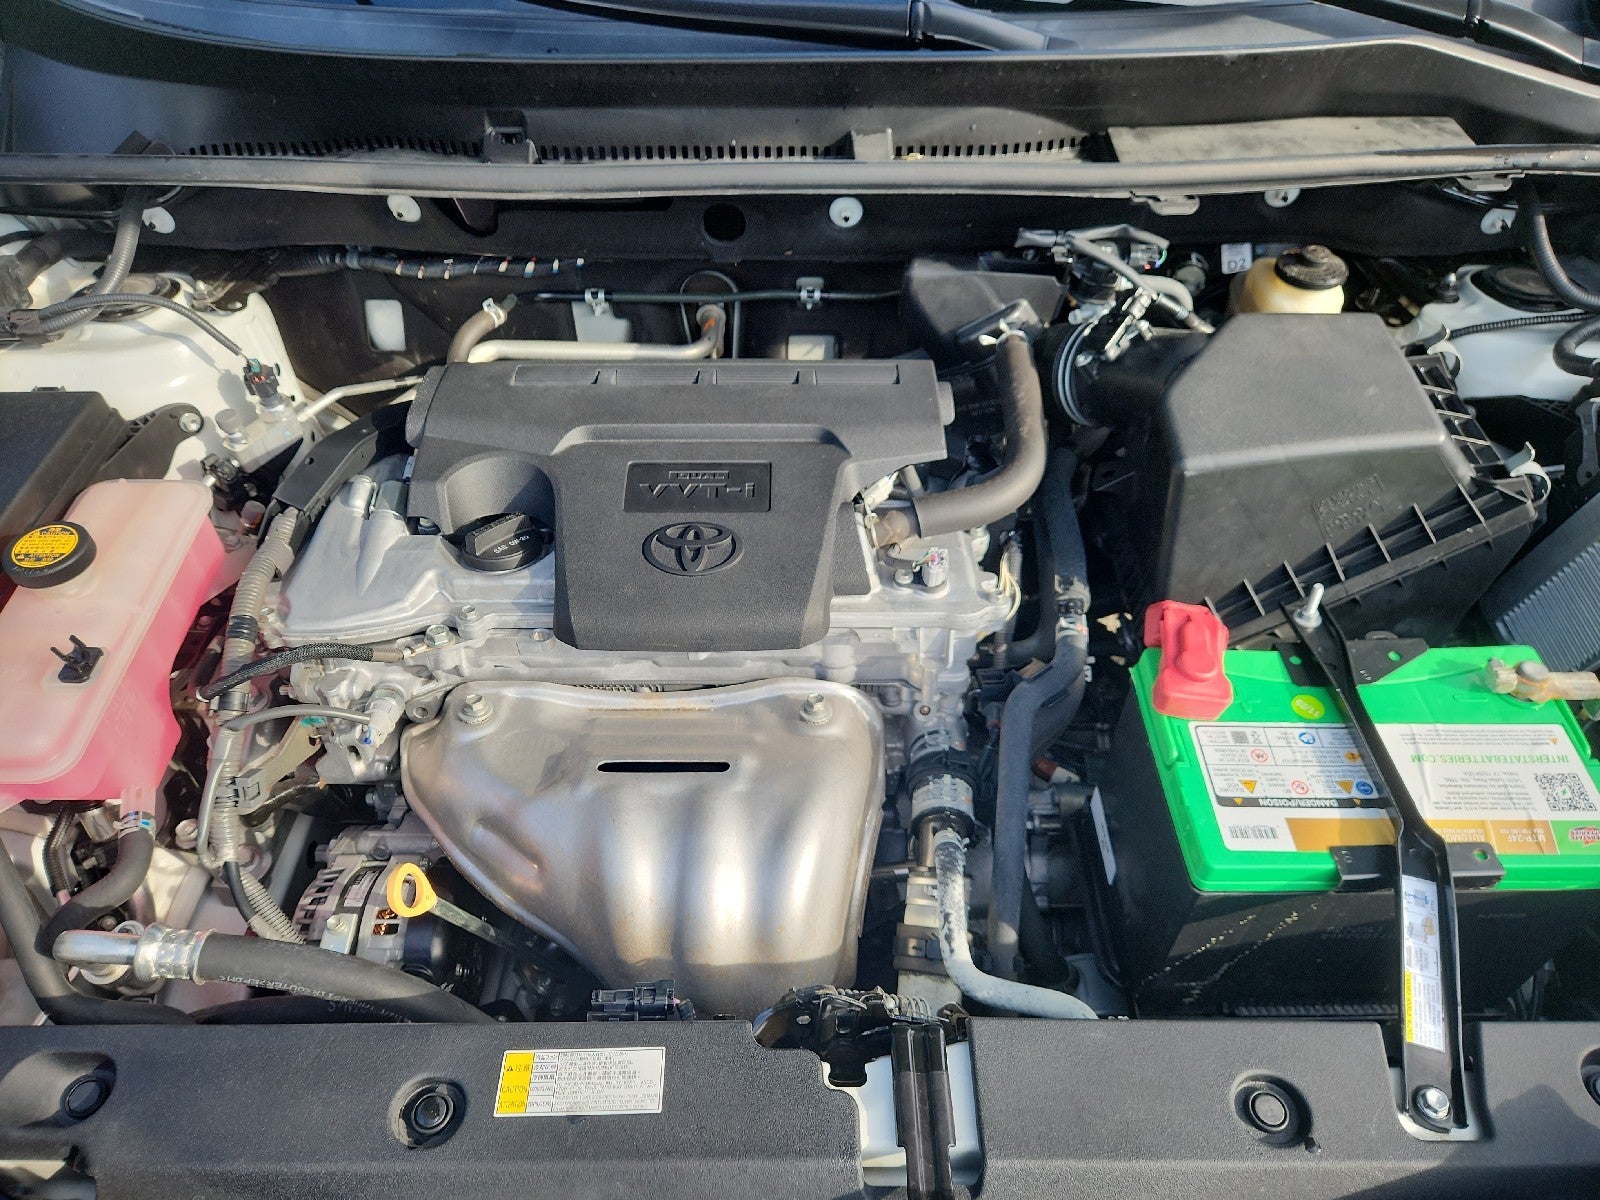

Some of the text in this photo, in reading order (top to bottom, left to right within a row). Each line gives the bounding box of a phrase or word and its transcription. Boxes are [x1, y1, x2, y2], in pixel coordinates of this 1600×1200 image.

[1227, 258, 1246, 272] D2
[639, 482, 756, 498] VVT-i
[493, 535, 530, 554] SAE 0W-20
[1410, 754, 1569, 763] INTERSTATEBATTERIES.COM
[1258, 798, 1338, 807] DANGER/POISON
